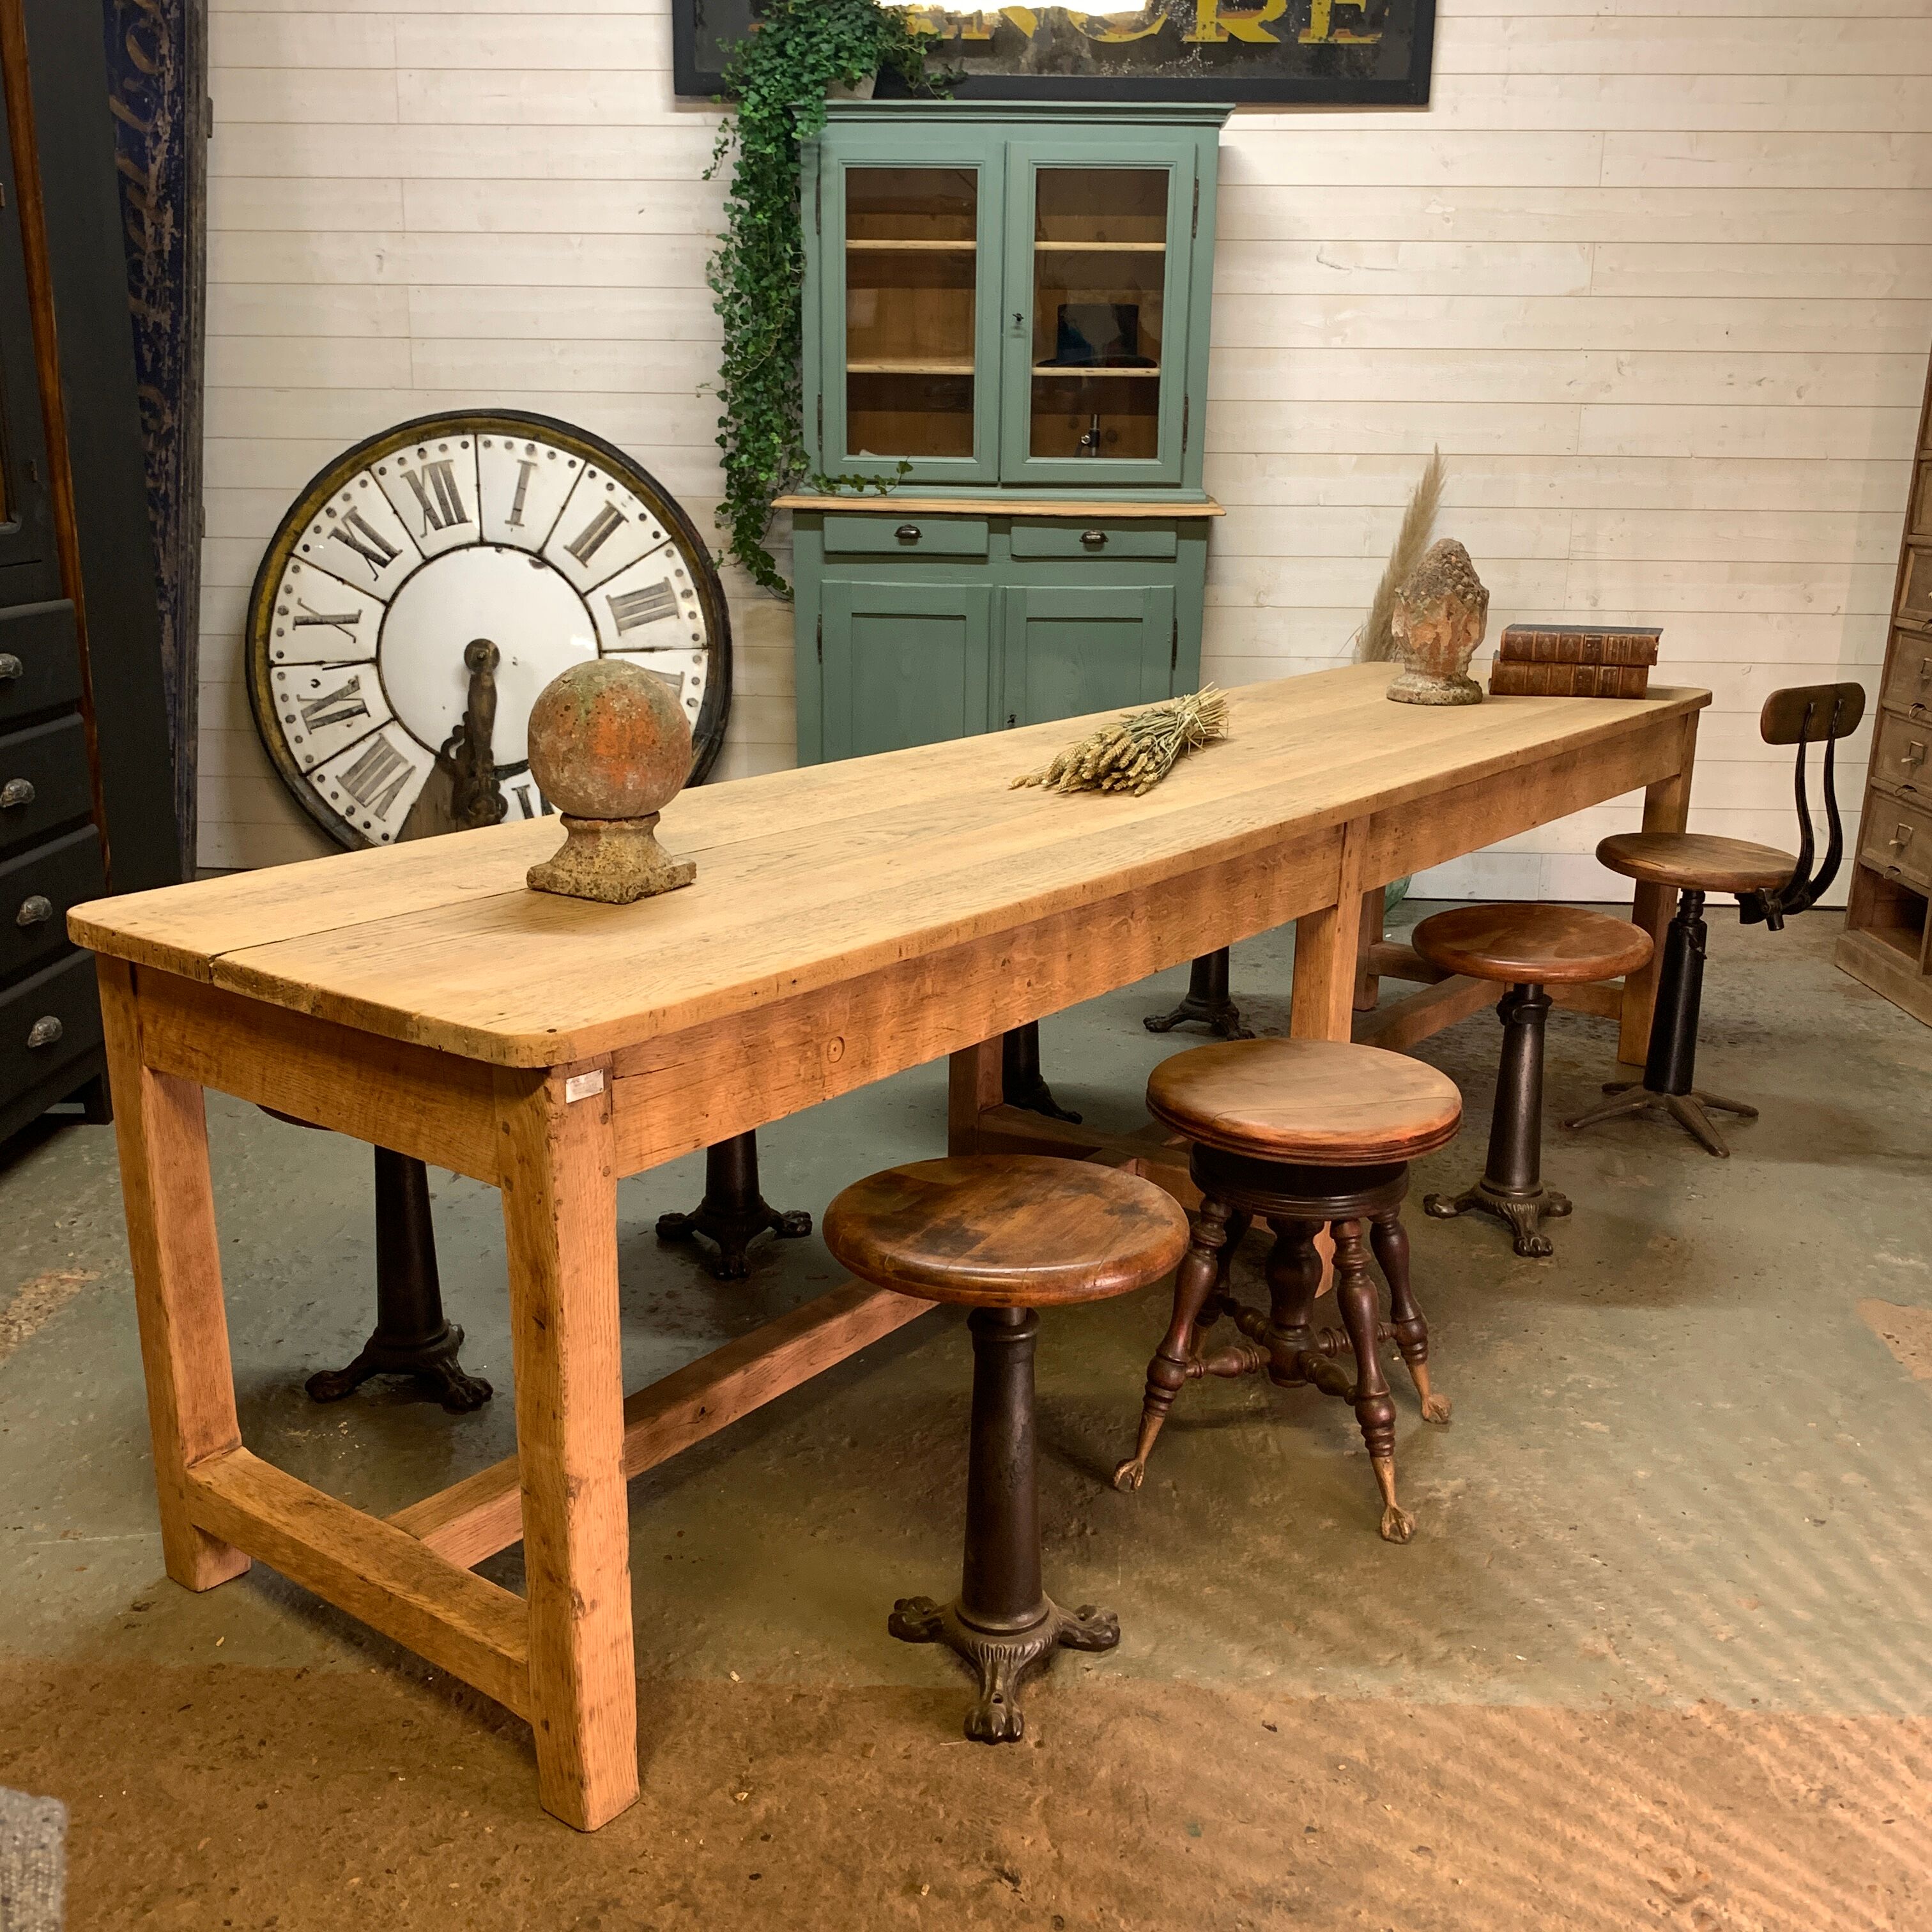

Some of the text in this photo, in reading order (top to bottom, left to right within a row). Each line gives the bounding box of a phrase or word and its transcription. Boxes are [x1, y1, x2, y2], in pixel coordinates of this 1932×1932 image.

[400, 459, 472, 539] XII
[505, 459, 537, 527] I
[327, 506, 403, 582] XI
[564, 500, 630, 568] II
[293, 597, 363, 643] X
[606, 576, 680, 637] III
[296, 675, 371, 735] IX
[335, 732, 417, 822] VIII
